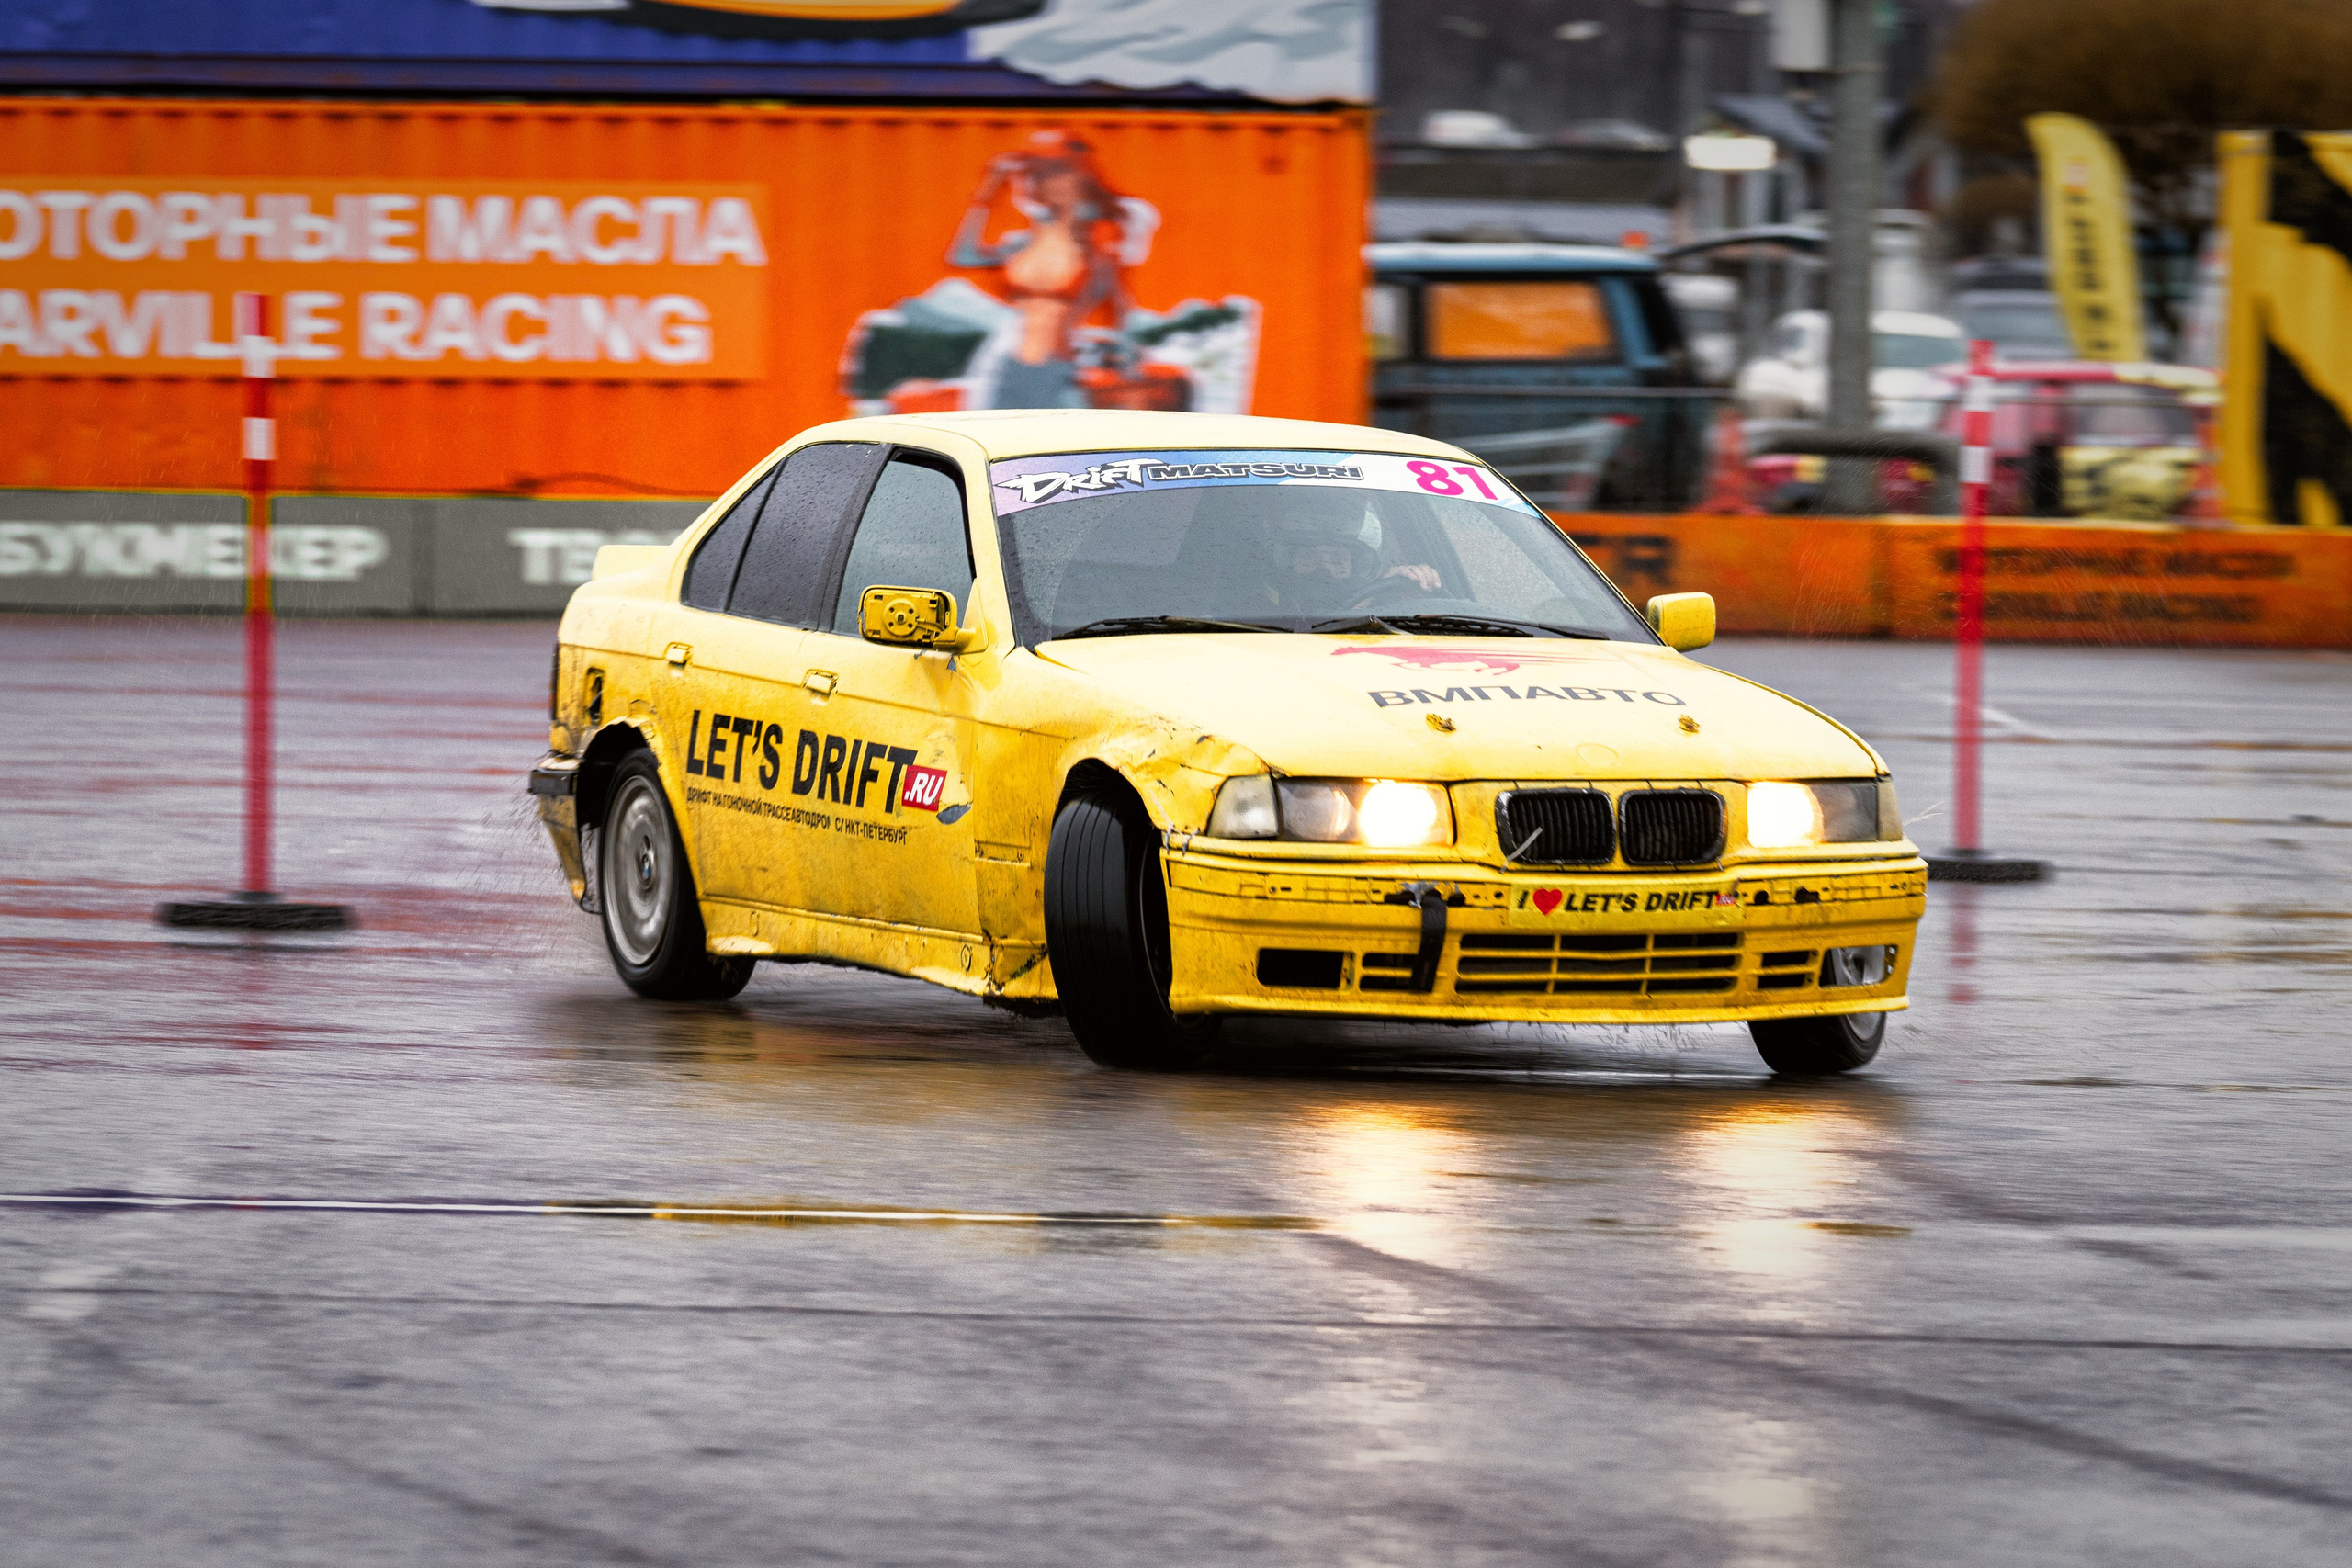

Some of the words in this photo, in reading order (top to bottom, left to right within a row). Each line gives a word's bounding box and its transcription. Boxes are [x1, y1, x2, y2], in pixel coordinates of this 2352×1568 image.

[425, 195, 768, 266] МАСЛА
[359, 292, 714, 365] RACING
[1147, 462, 1365, 481] MATSURI
[1406, 460, 1498, 501] 81
[1367, 685, 1688, 708] ВМПАВТО
[685, 709, 784, 791] LET'S
[791, 728, 919, 815] DRIFT
[763, 802, 792, 822] ТРАССЕ
[1517, 890, 1530, 910] I
[1564, 892, 1640, 913] LET'S
[1643, 891, 1721, 912] DRIFT
